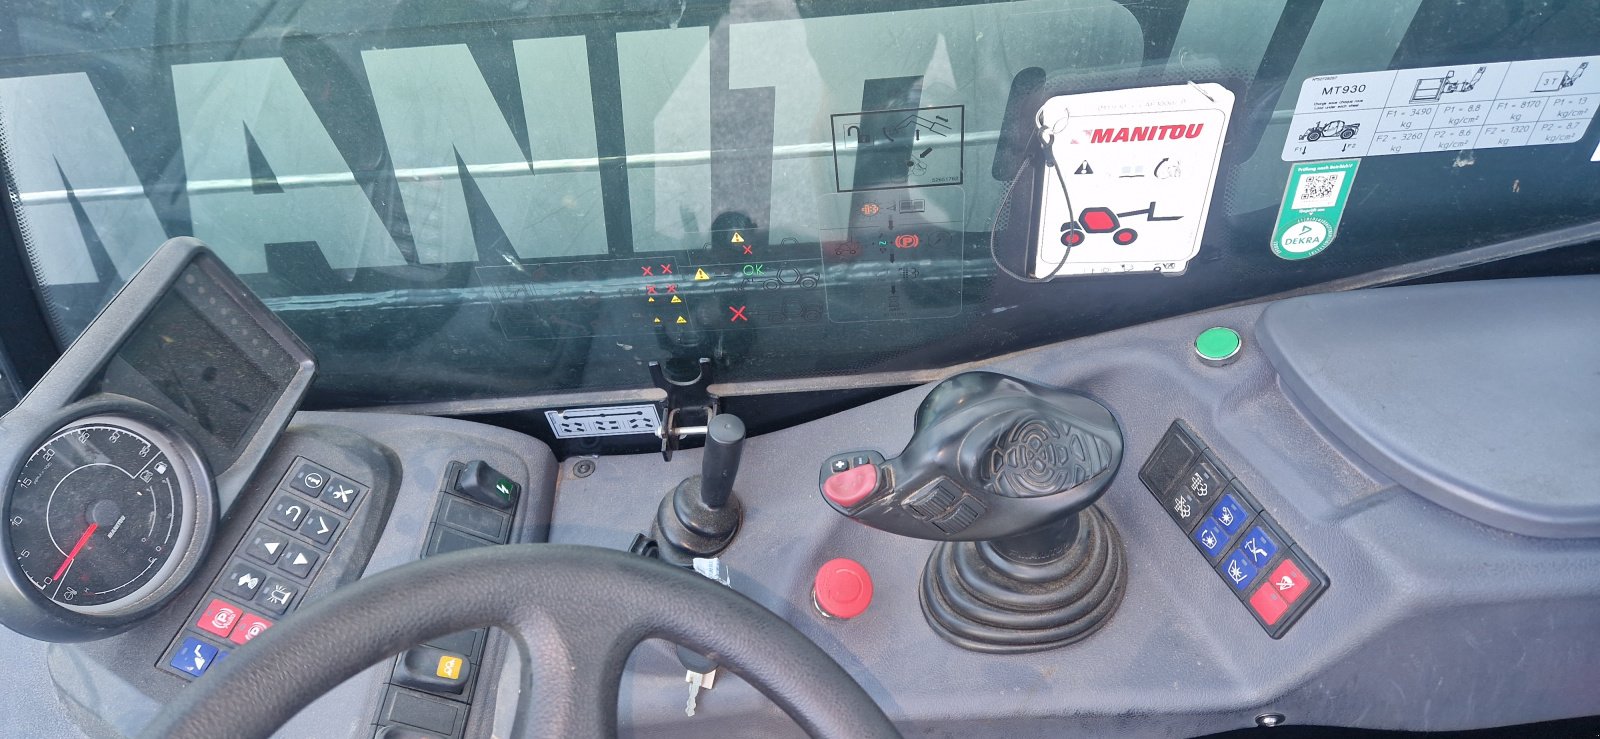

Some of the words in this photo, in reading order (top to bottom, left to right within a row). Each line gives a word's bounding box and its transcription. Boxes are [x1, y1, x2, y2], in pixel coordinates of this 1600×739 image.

[1322, 84, 1366, 95] MT930
[1497, 102, 1508, 110] F1
[1520, 100, 1541, 109] 8170
[1553, 98, 1565, 106] P1
[1579, 97, 1588, 105] 13
[1409, 107, 1432, 116] 3490
[1468, 104, 1481, 112] 8.8
[1510, 113, 1521, 121] kg
[1400, 121, 1412, 129] kg
[1484, 127, 1497, 135] F2
[1511, 125, 1530, 134] 1320
[1541, 123, 1554, 131] P2
[1566, 121, 1580, 130] 8.7
[1090, 123, 1204, 144] MANITOU
[1375, 134, 1388, 142] F2
[1401, 132, 1423, 141] 3260
[1498, 138, 1509, 146] kg
[1390, 145, 1401, 153] kg
[1285, 236, 1320, 246] DEKRA
[743, 264, 765, 276] OK
[109, 431, 121, 444] 30
[42, 448, 55, 462] 20
[21, 477, 32, 489] 15
[12, 515, 23, 526] 10
[21, 549, 30, 558] 5
[44, 576, 53, 585] 0
